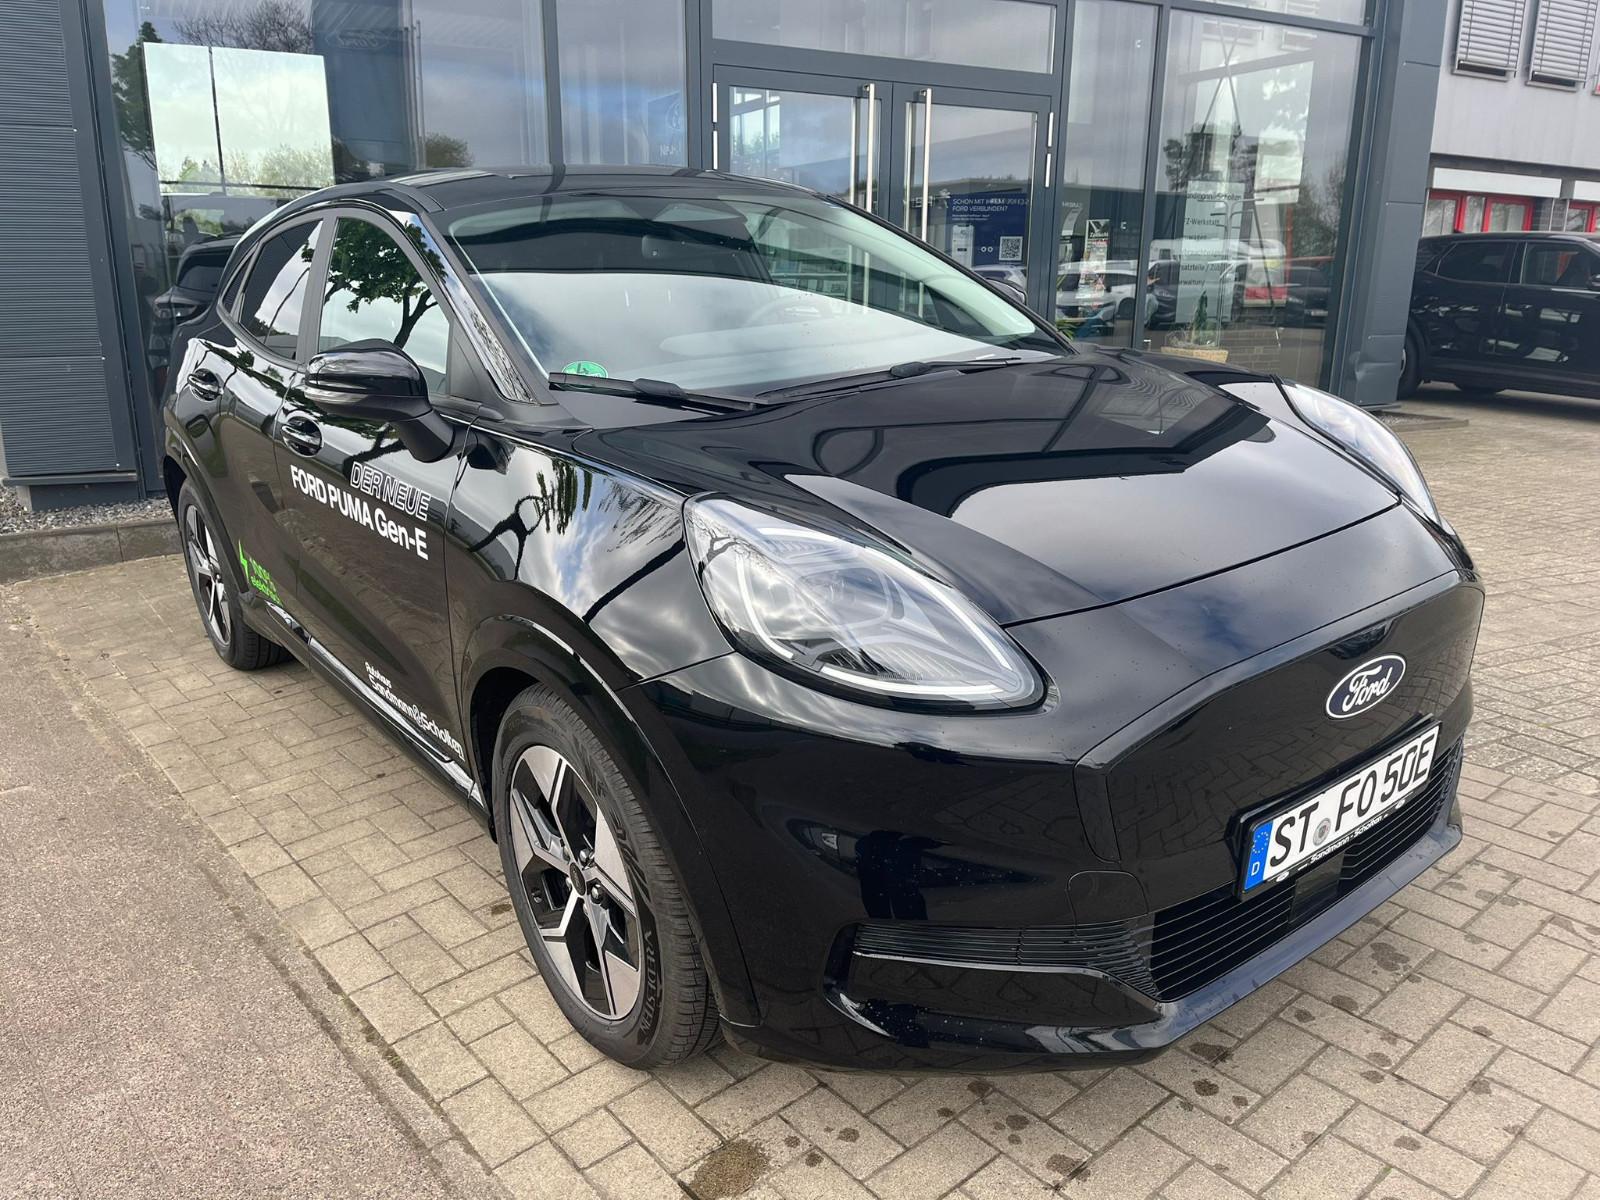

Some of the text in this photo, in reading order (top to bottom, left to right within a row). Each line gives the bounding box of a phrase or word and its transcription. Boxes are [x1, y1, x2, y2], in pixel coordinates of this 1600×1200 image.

[290, 464, 429, 560] FORD PUMA Gen-E
[351, 461, 431, 522] DER NEUE
[1342, 664, 1394, 712] Ford
[1270, 801, 1320, 868] ST
[1250, 862, 1261, 876] D
[640, 930, 656, 1034] VREDESTEIN
